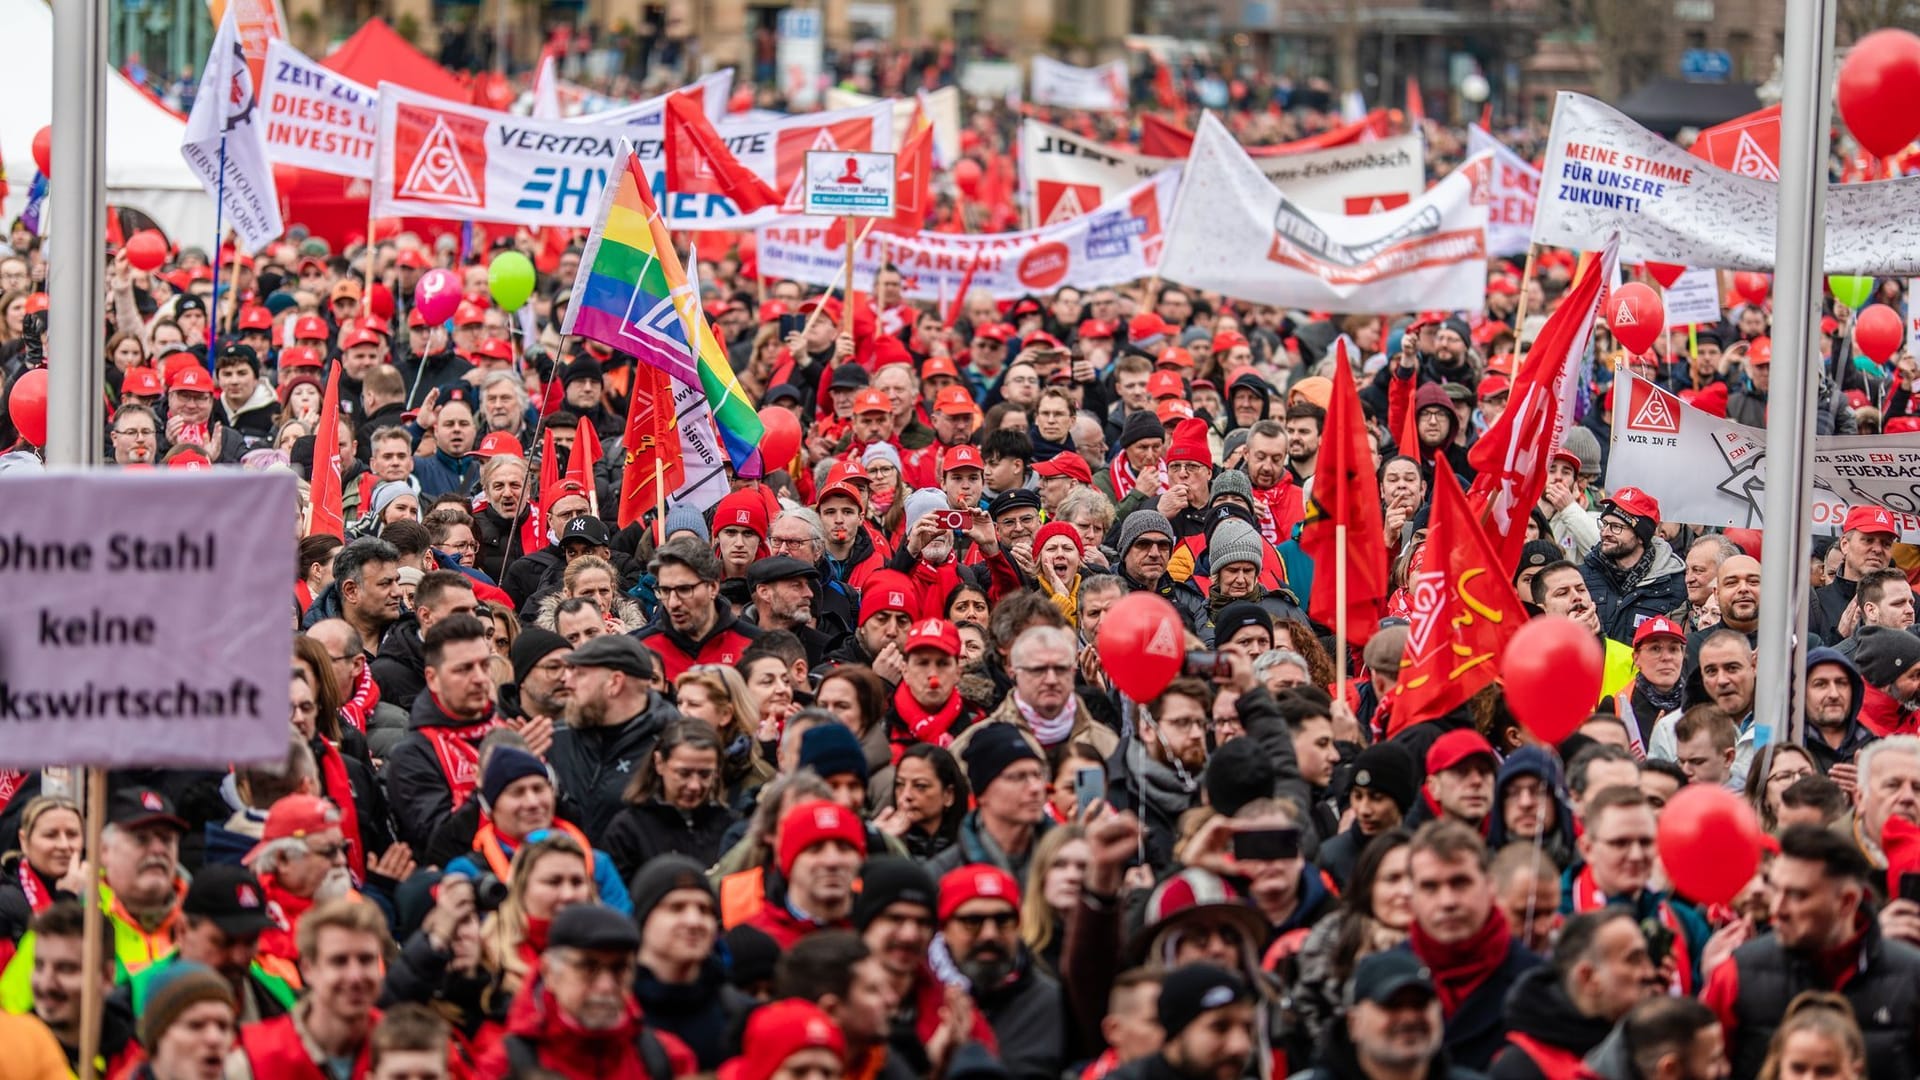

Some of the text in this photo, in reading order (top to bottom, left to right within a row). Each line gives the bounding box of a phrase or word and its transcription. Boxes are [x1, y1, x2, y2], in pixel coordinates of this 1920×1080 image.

[276, 60, 326, 91] ZEIT
[271, 93, 353, 127] DIESES
[1565, 142, 1694, 185] MEINE STIMME
[1562, 161, 1666, 199] FÜR UNSERE
[1558, 184, 1641, 214] ZUKUNFT!
[1627, 434, 1648, 445] WIR
[1652, 436, 1664, 446] IN
[1834, 454, 1865, 463] SIND
[1869, 453, 1894, 463] EIN
[571, 518, 586, 531] NY
[107, 531, 217, 571] Stahl
[38, 609, 156, 647] keine
